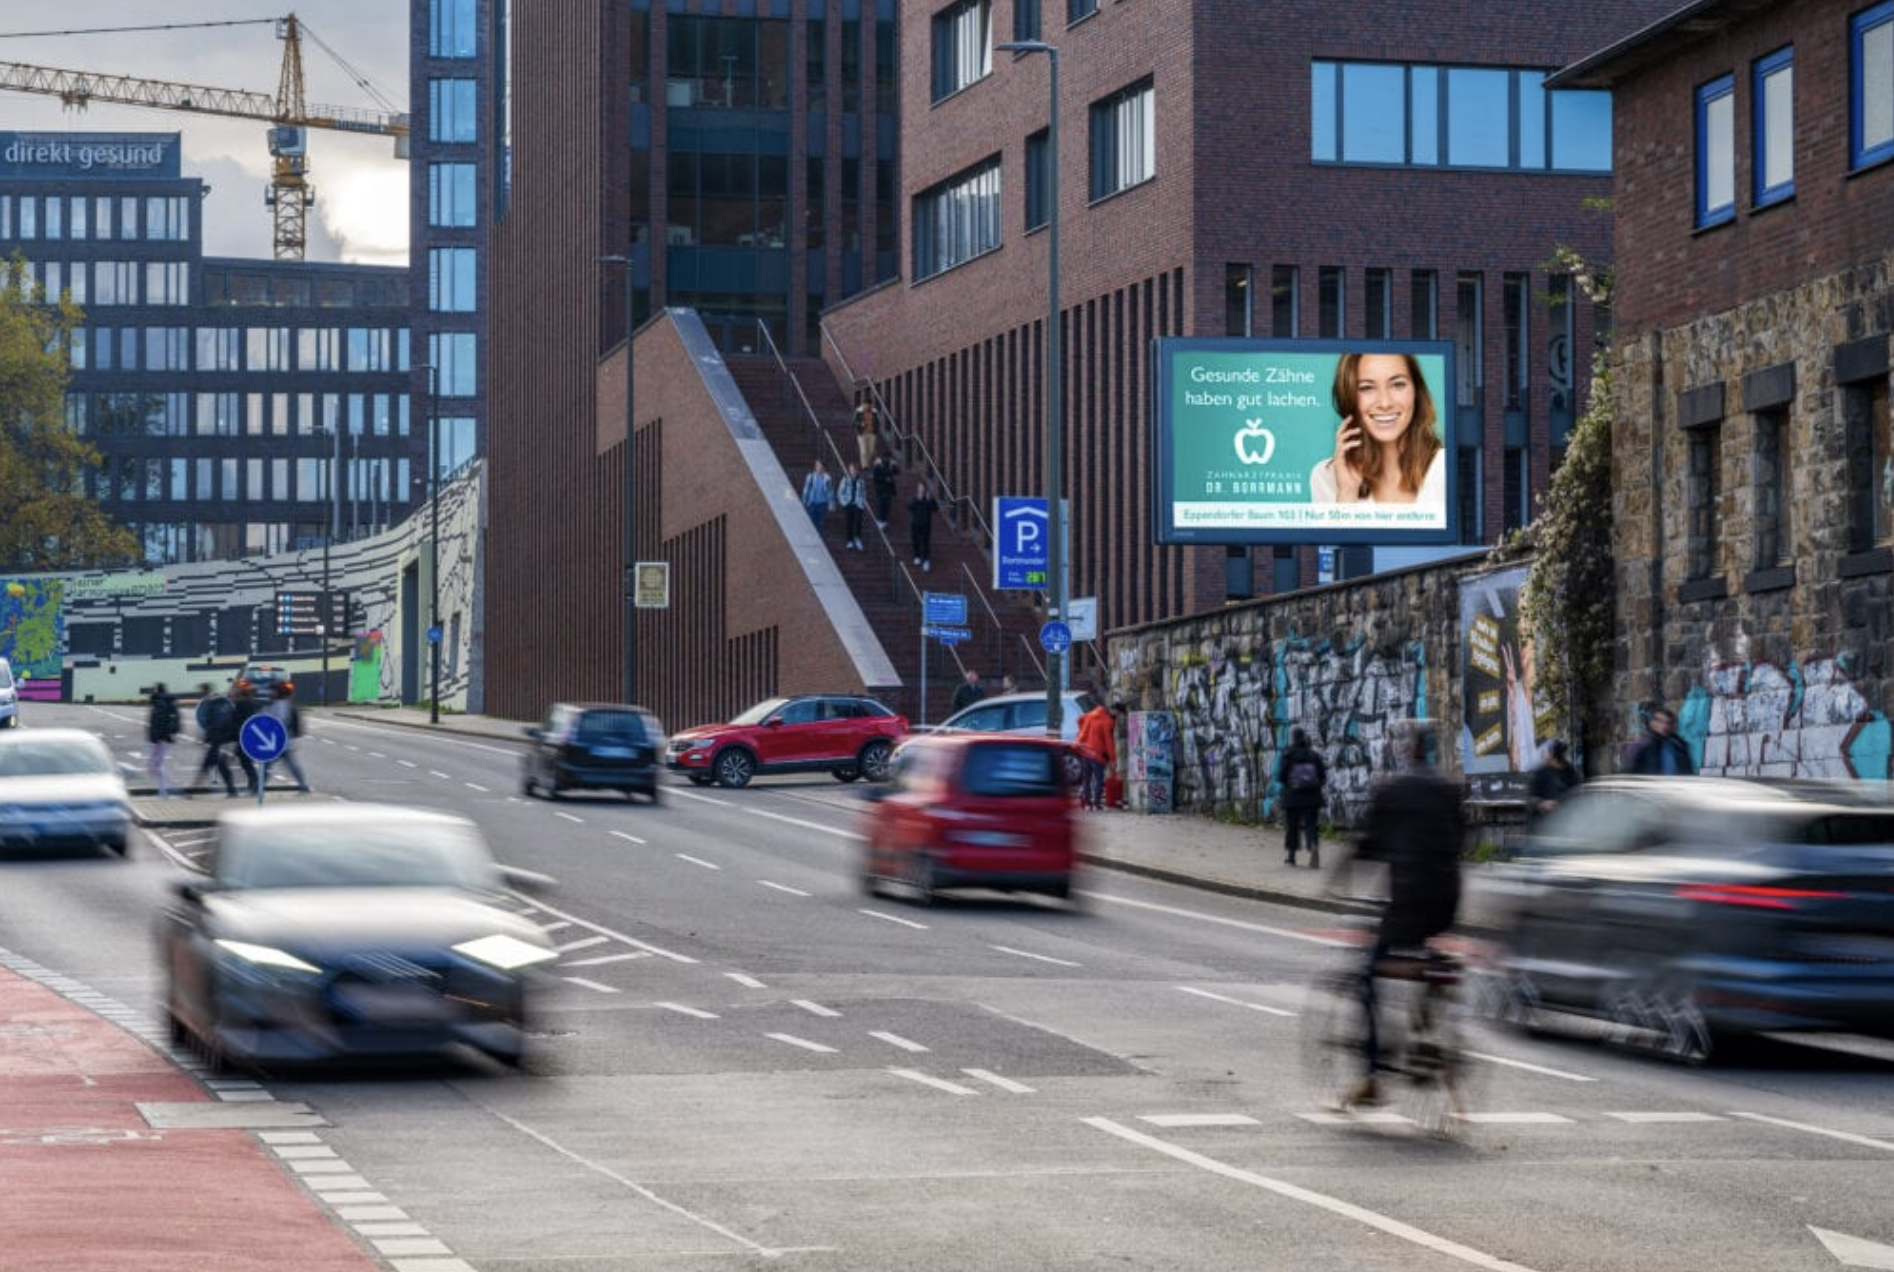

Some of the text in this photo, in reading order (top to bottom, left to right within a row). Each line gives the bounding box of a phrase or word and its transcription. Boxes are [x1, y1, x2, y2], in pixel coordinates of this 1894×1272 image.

[5, 141, 163, 169] direkt gesund
[1190, 366, 1315, 383] Gesunde Zähne
[1185, 390, 1321, 410] haben gut lachen.
[1182, 508, 1244, 521] Eppendorfer
[1305, 508, 1326, 520] Nur
[1016, 520, 1039, 552] P
